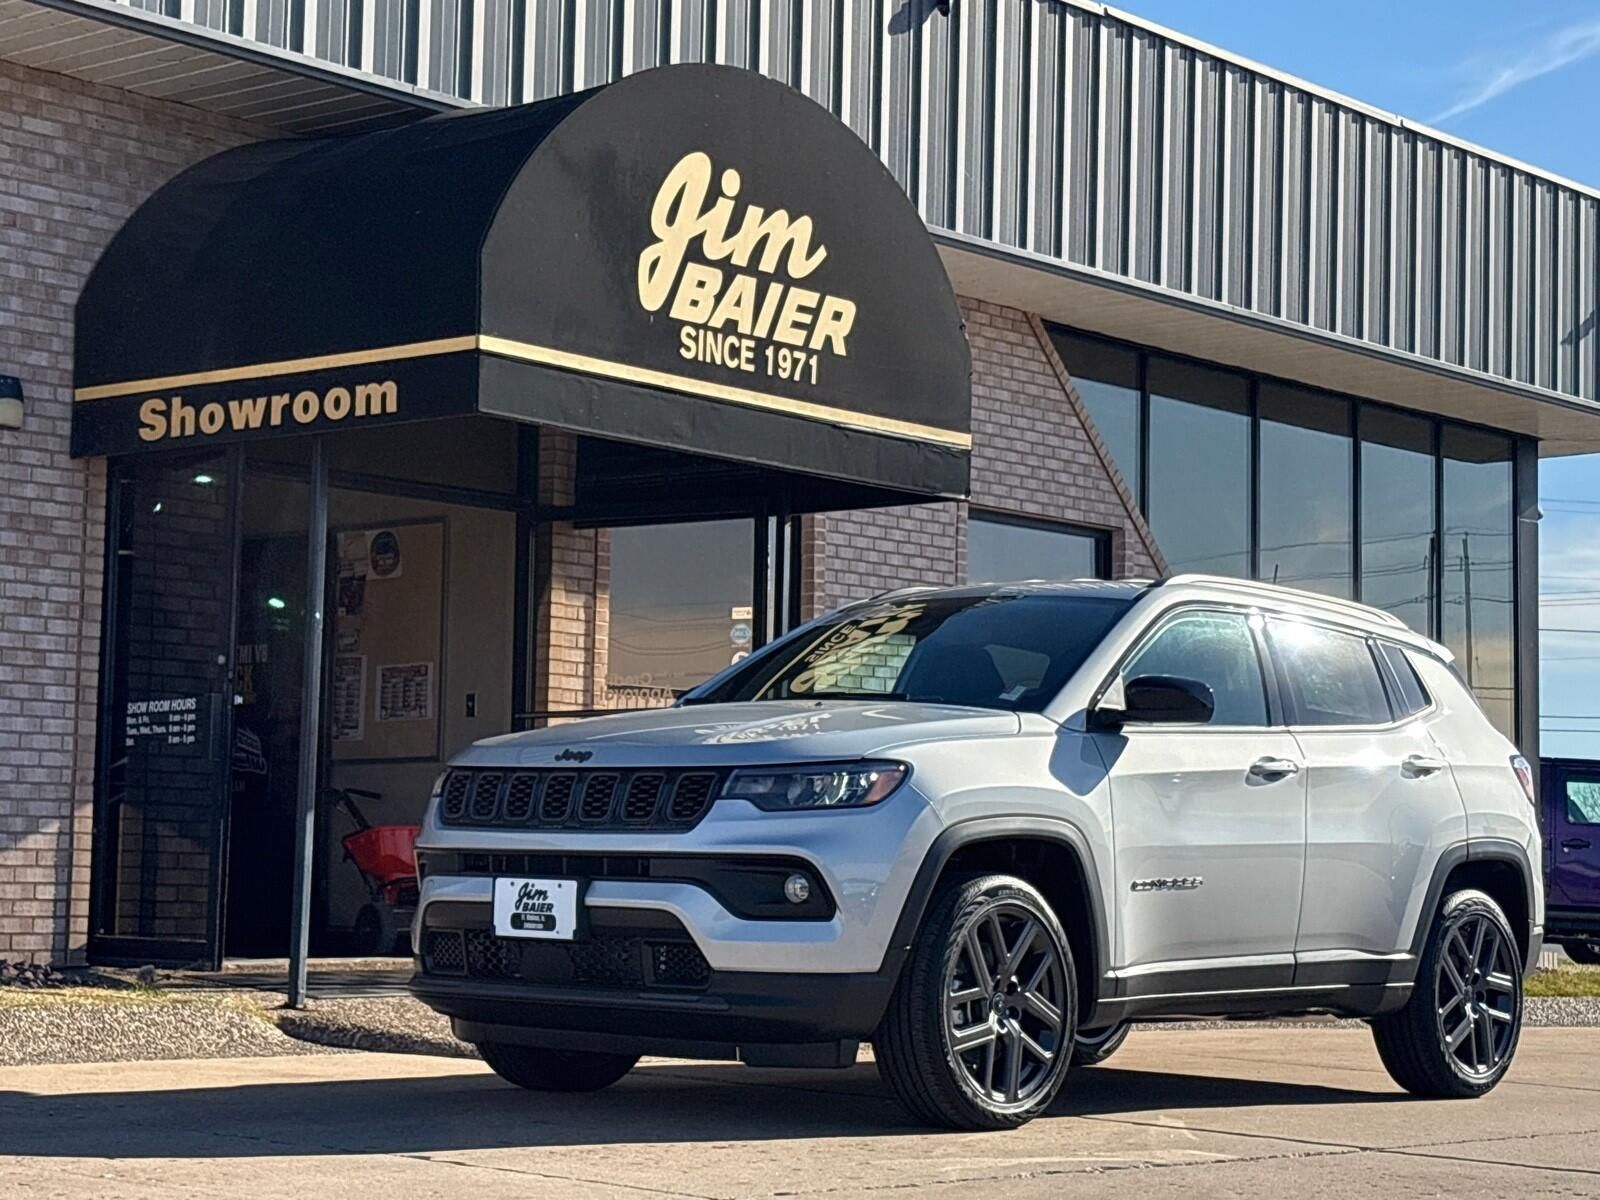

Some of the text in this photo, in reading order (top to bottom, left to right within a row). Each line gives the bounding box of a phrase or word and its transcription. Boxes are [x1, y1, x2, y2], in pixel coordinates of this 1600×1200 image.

[637, 151, 828, 312] Jim
[669, 262, 857, 357] BAIER
[679, 325, 819, 385] SINCE 1971
[138, 380, 398, 442] Showroom
[127, 697, 197, 714] SHOW ROOM HOURS
[514, 881, 550, 912] Jim
[522, 902, 555, 914] BAIER
